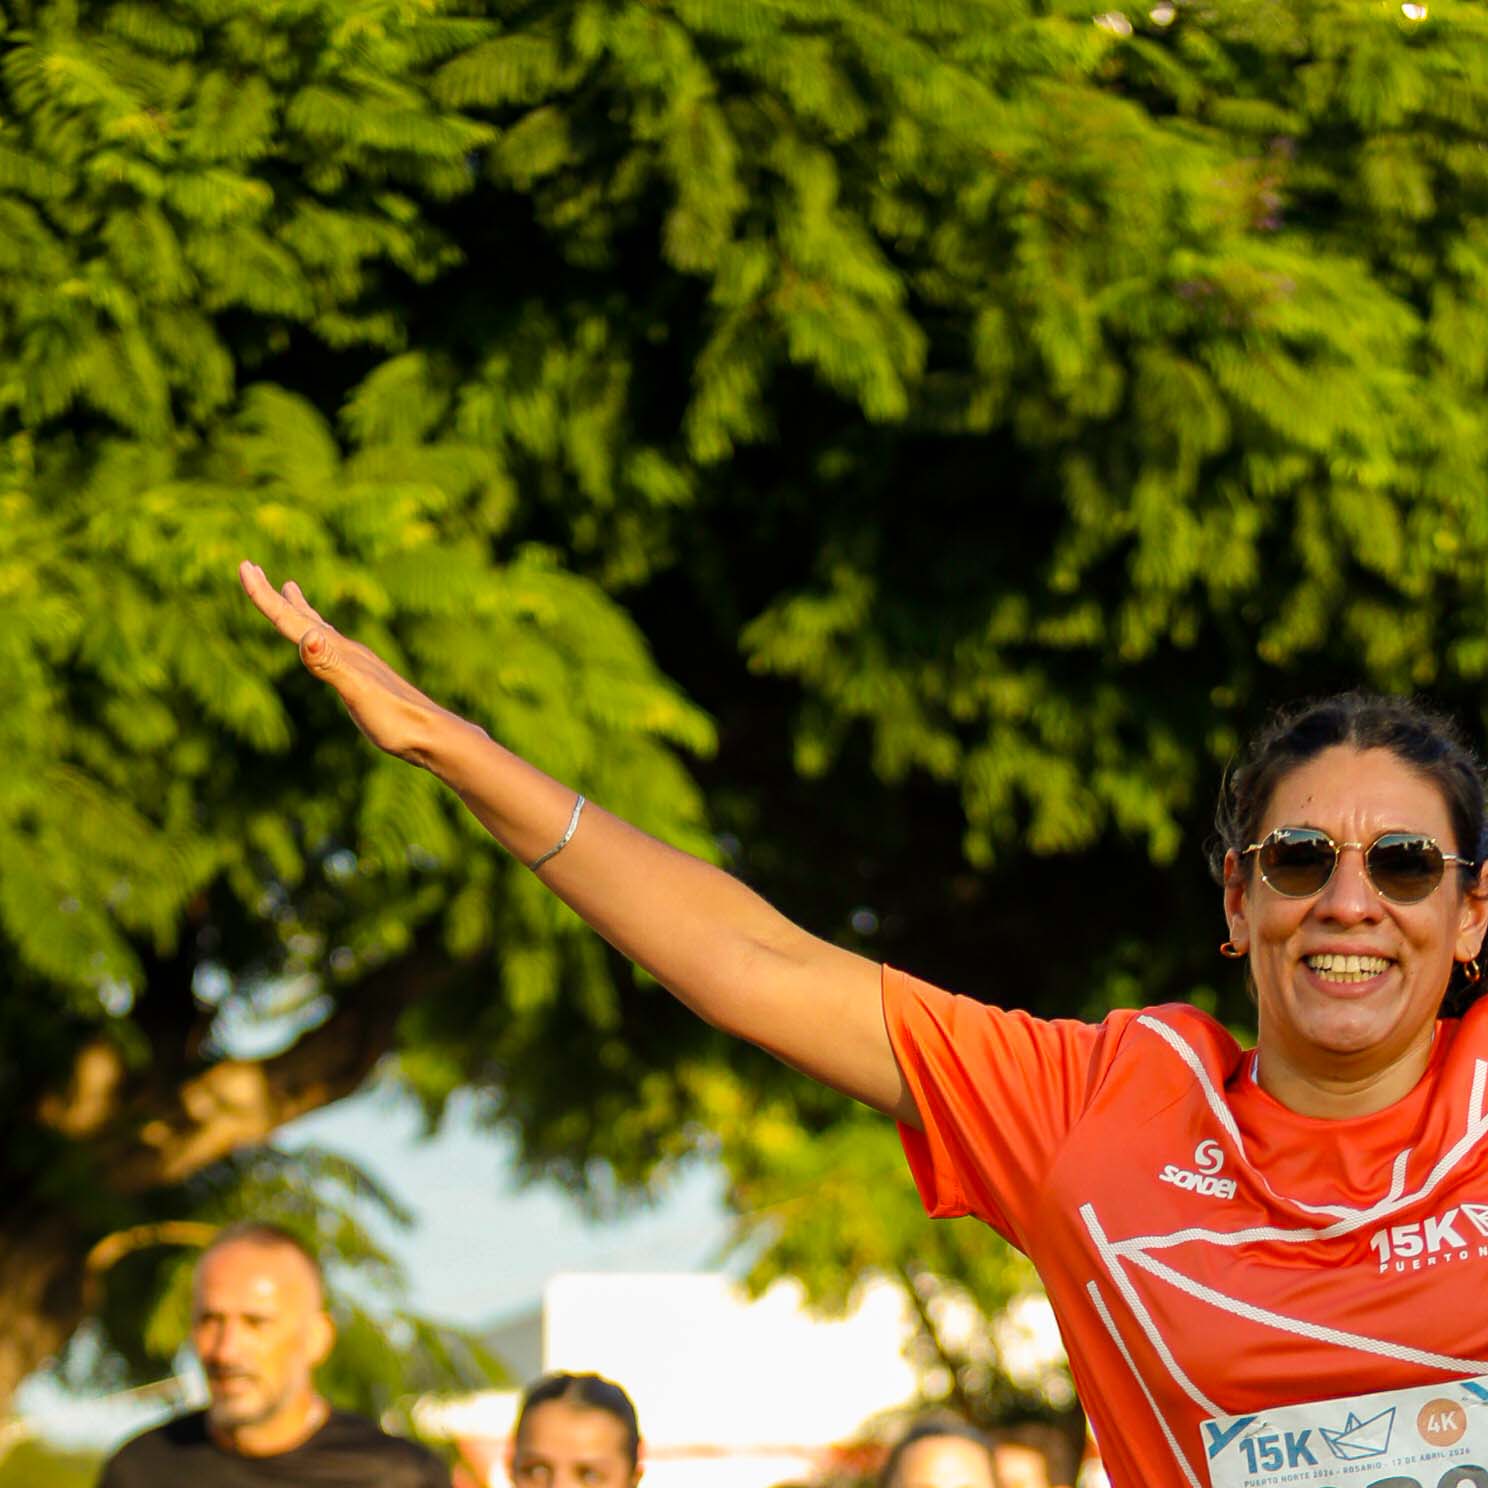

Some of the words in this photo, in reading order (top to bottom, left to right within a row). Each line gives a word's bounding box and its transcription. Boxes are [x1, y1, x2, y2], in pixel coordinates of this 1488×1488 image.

[1370, 1207, 1467, 1264] 15K
[1379, 1250, 1469, 1274] PUERTO
[1427, 1410, 1459, 1433] 4K
[1238, 1428, 1319, 1474] 15K
[1243, 1476, 1279, 1488] PUERTO
[1281, 1471, 1310, 1483] NORTE
[1342, 1462, 1383, 1474] ROSARIO
[1405, 1455, 1417, 1465] DE
[1420, 1450, 1446, 1462] ABRIL
